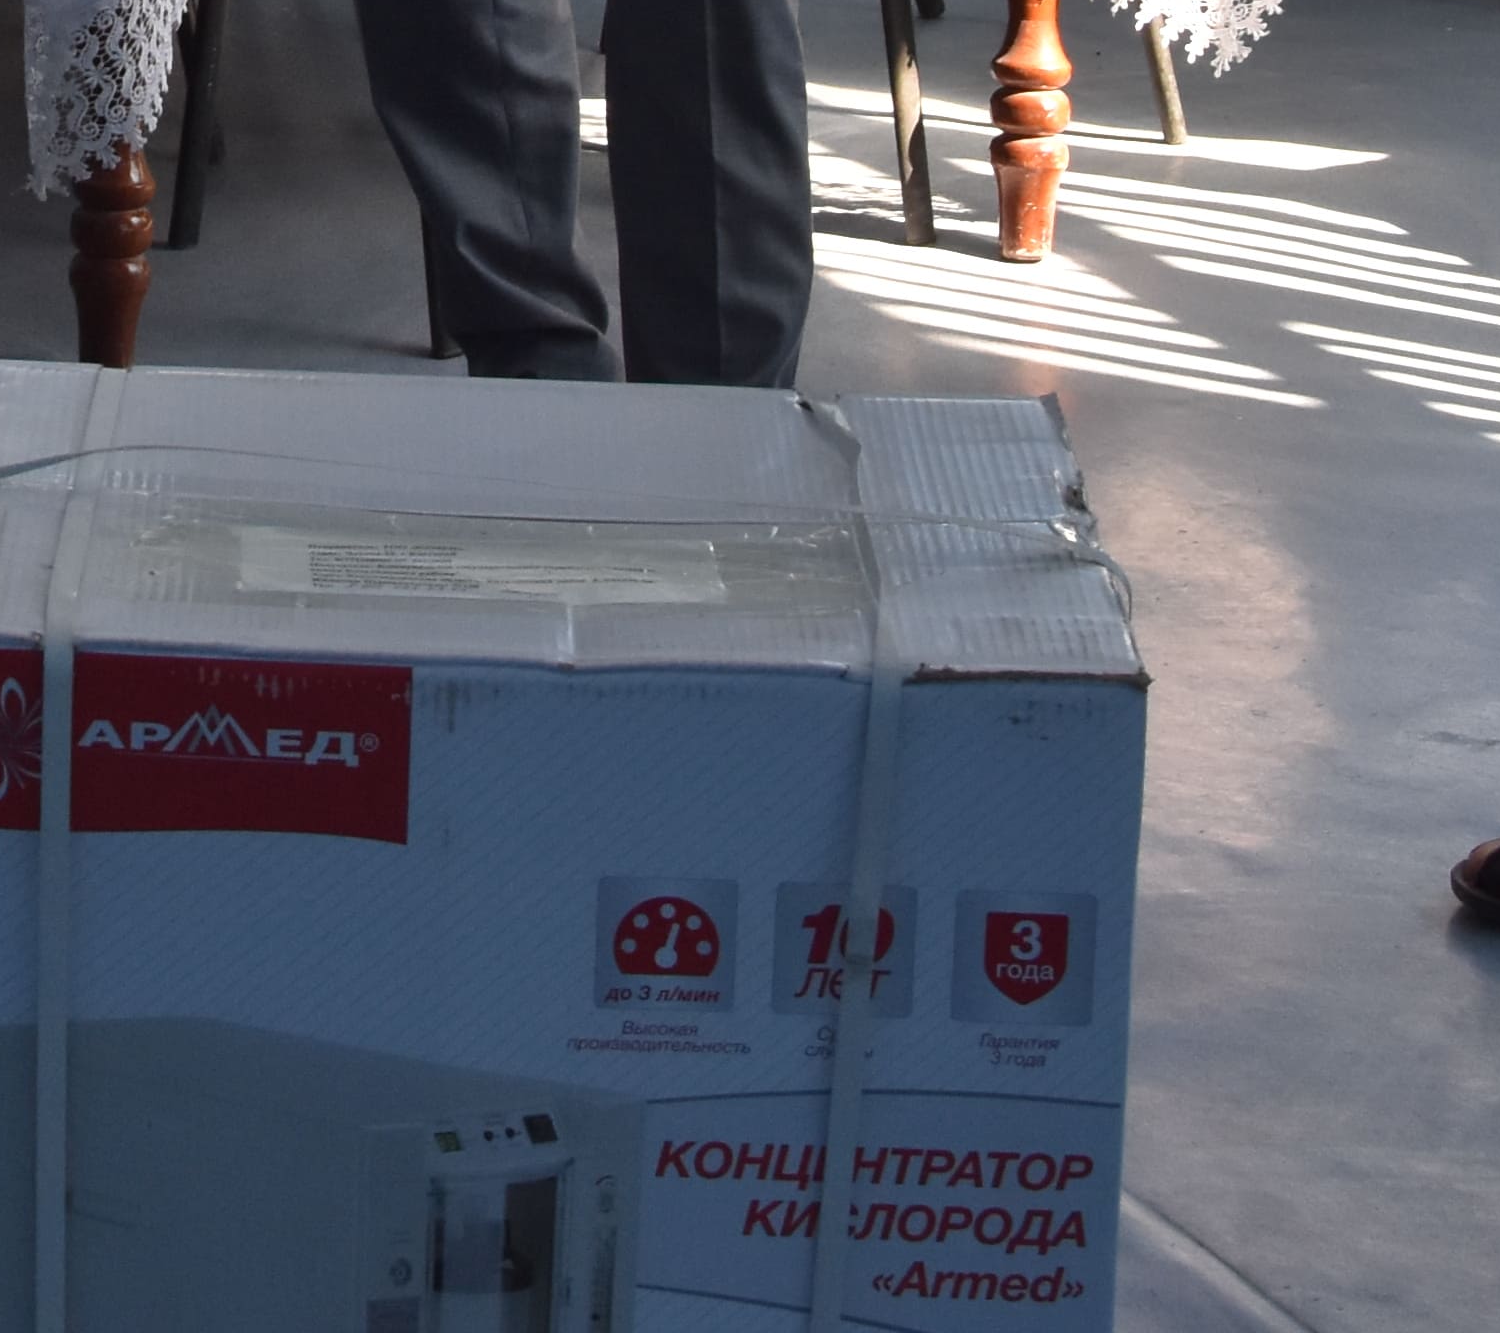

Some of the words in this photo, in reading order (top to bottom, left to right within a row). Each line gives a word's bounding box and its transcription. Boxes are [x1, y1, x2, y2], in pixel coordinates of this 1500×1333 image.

[1010, 920, 1043, 961] 3
[996, 963, 1054, 983] года
[604, 987, 632, 1003] до
[638, 986, 651, 1001] 3
[656, 986, 720, 1003] л/мин
[621, 1020, 698, 1036] Высокая
[567, 1036, 751, 1055] производительность
[979, 1033, 1060, 1051] Гарантия
[991, 1051, 1002, 1066] 3
[1006, 1053, 1047, 1069] года
[742, 1199, 1087, 1255] КИЛОРОДА
[872, 1260, 1084, 1304] «Armed»
